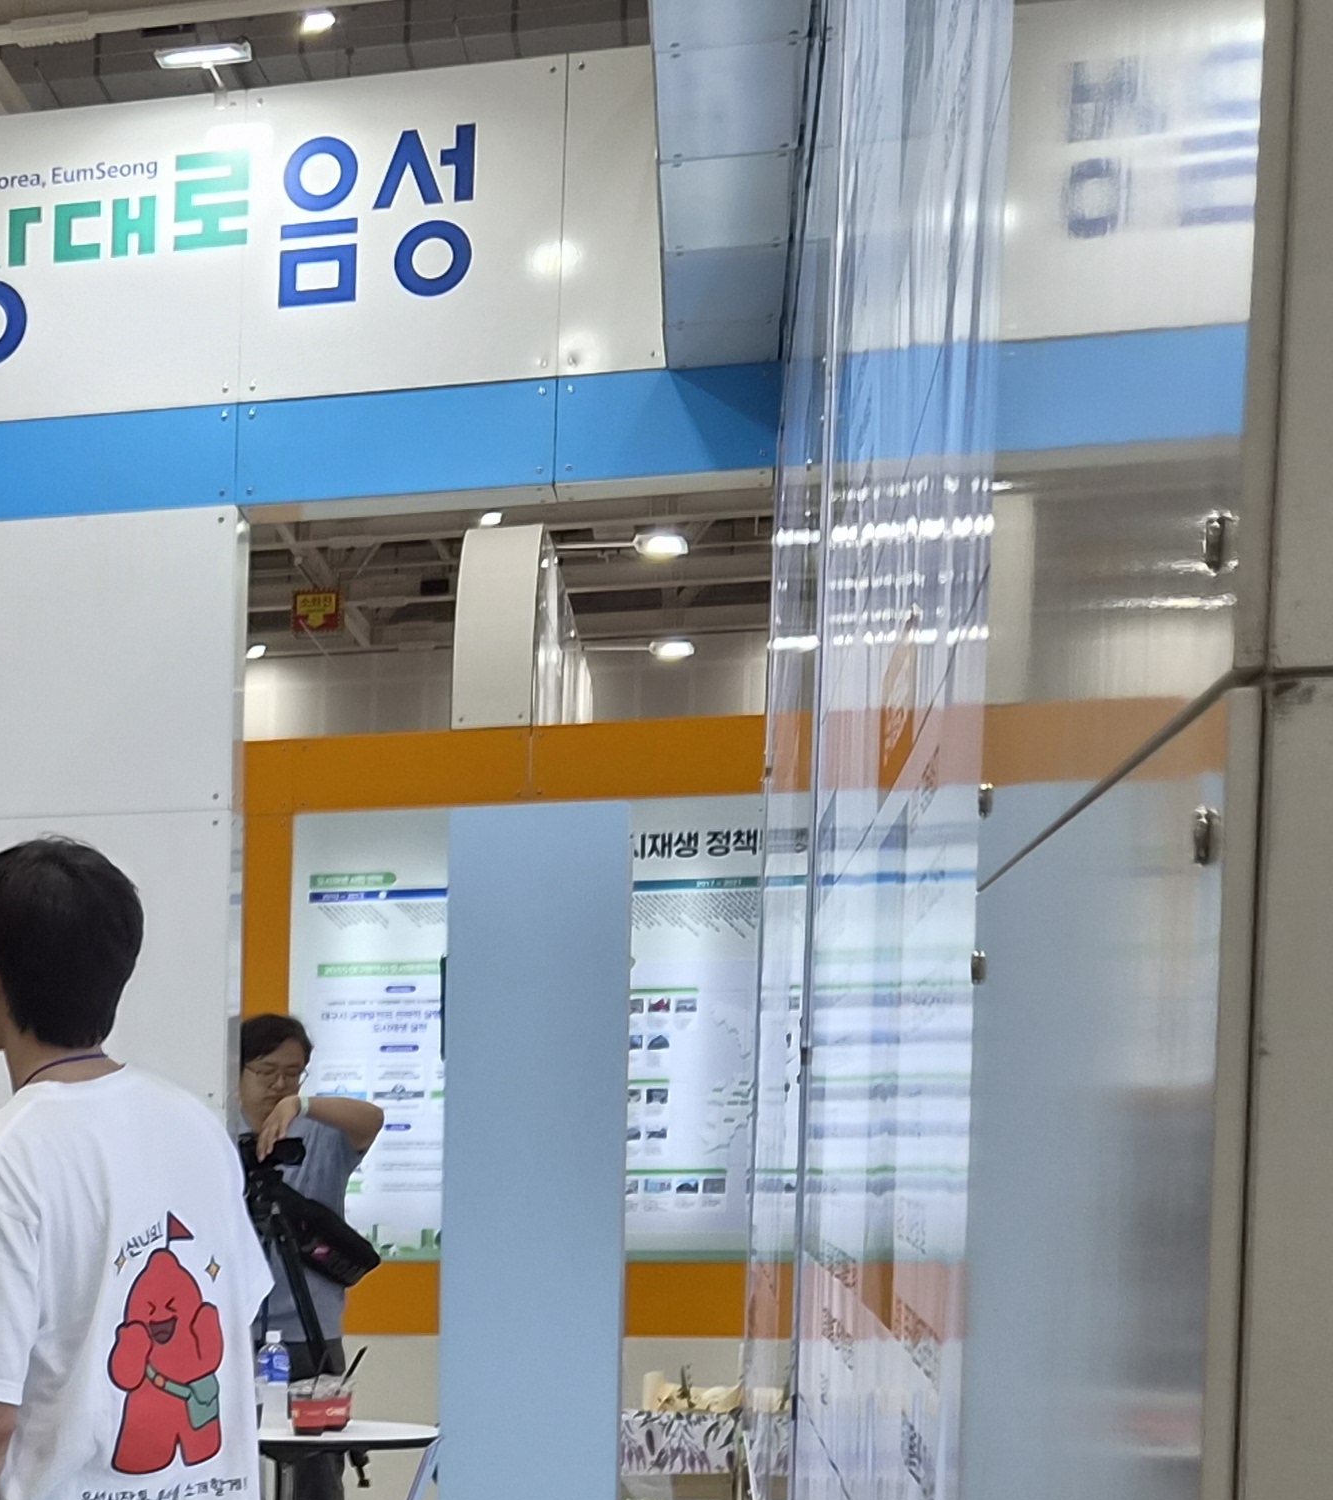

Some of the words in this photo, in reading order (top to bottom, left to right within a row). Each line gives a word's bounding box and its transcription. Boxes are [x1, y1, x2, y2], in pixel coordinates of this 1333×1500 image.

[51, 160, 158, 185] EumSeong
[279, 123, 476, 308] 음성
[707, 828, 763, 857] 정책
